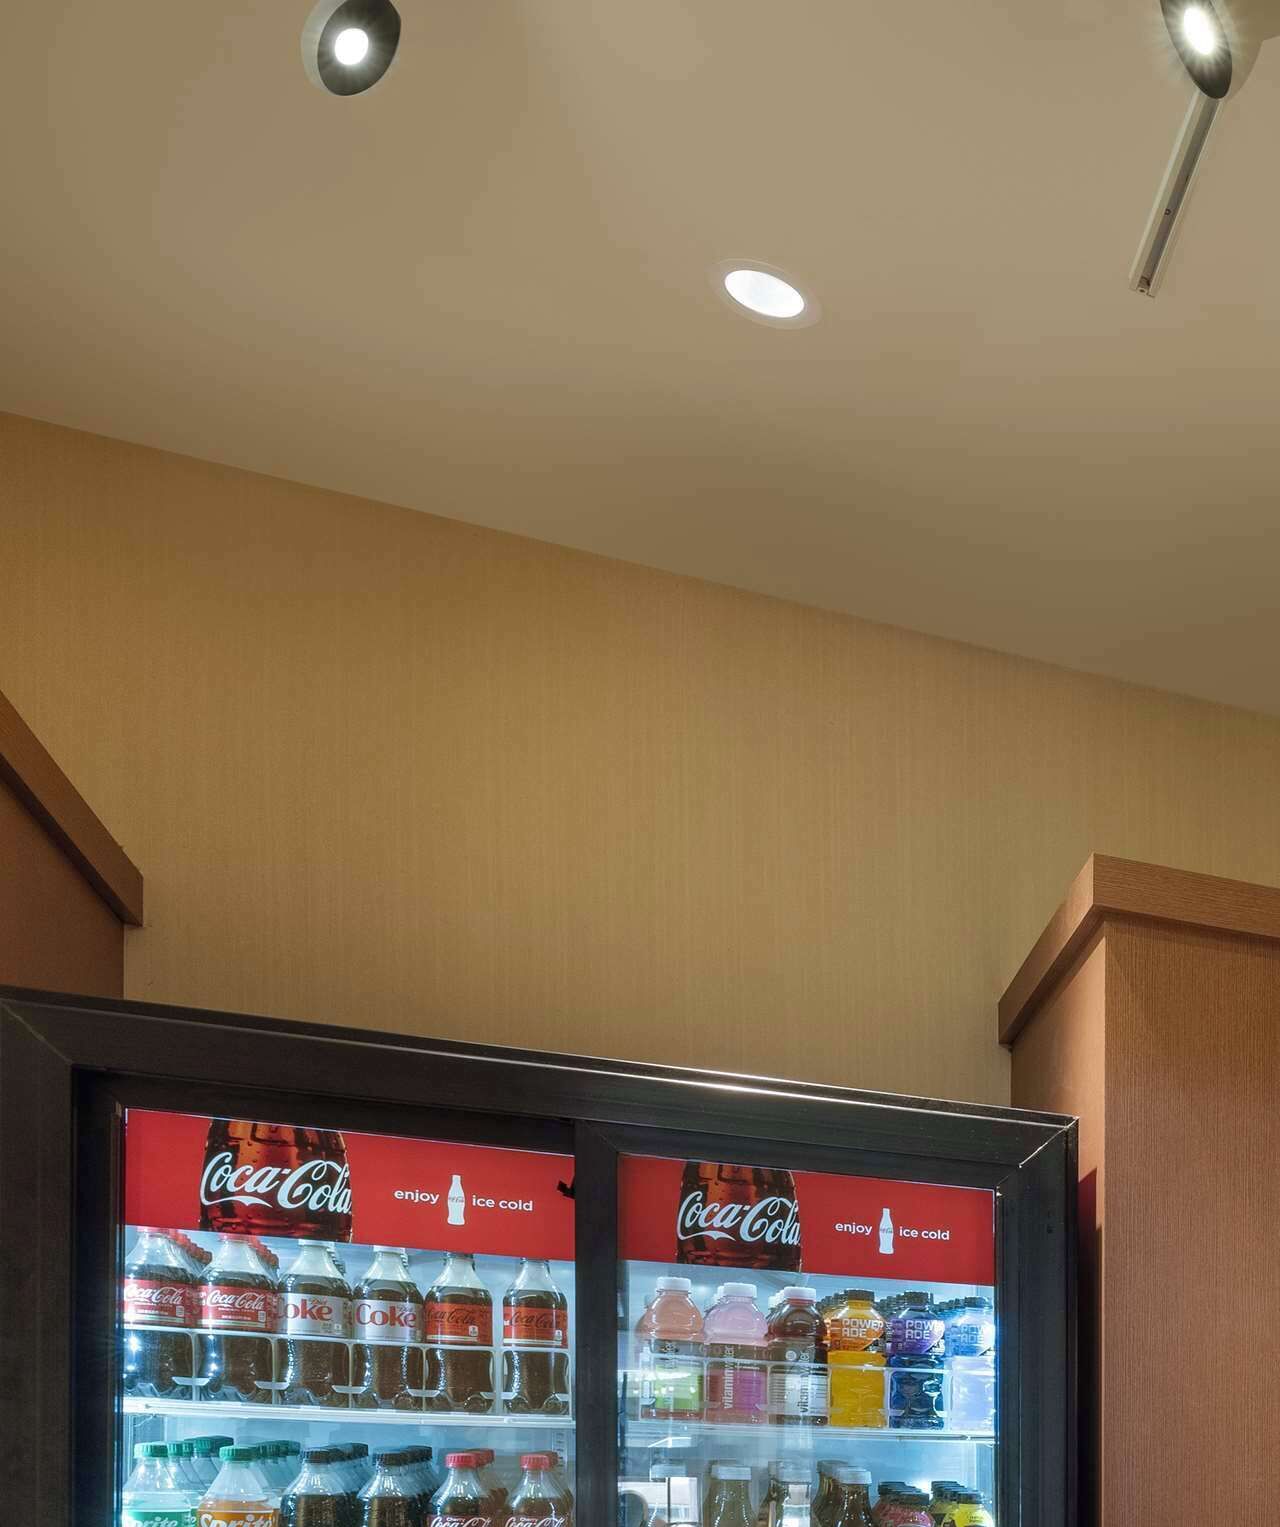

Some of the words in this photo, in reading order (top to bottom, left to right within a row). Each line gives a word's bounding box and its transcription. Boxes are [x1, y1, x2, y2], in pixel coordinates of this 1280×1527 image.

[200, 1151, 352, 1214] Coca-Cola
[394, 1188, 440, 1206] enjoy
[472, 1195, 495, 1208] ice
[498, 1197, 533, 1212] cold
[676, 1190, 801, 1247] Coca-Cola
[835, 1221, 873, 1237] enjoy
[899, 1227, 919, 1239] ice
[921, 1228, 950, 1241] cold
[206, 1288, 266, 1310] Coca-Cola
[356, 1303, 417, 1329] Coke
[842, 1327, 867, 1338] ADE
[905, 1329, 930, 1341] ADE
